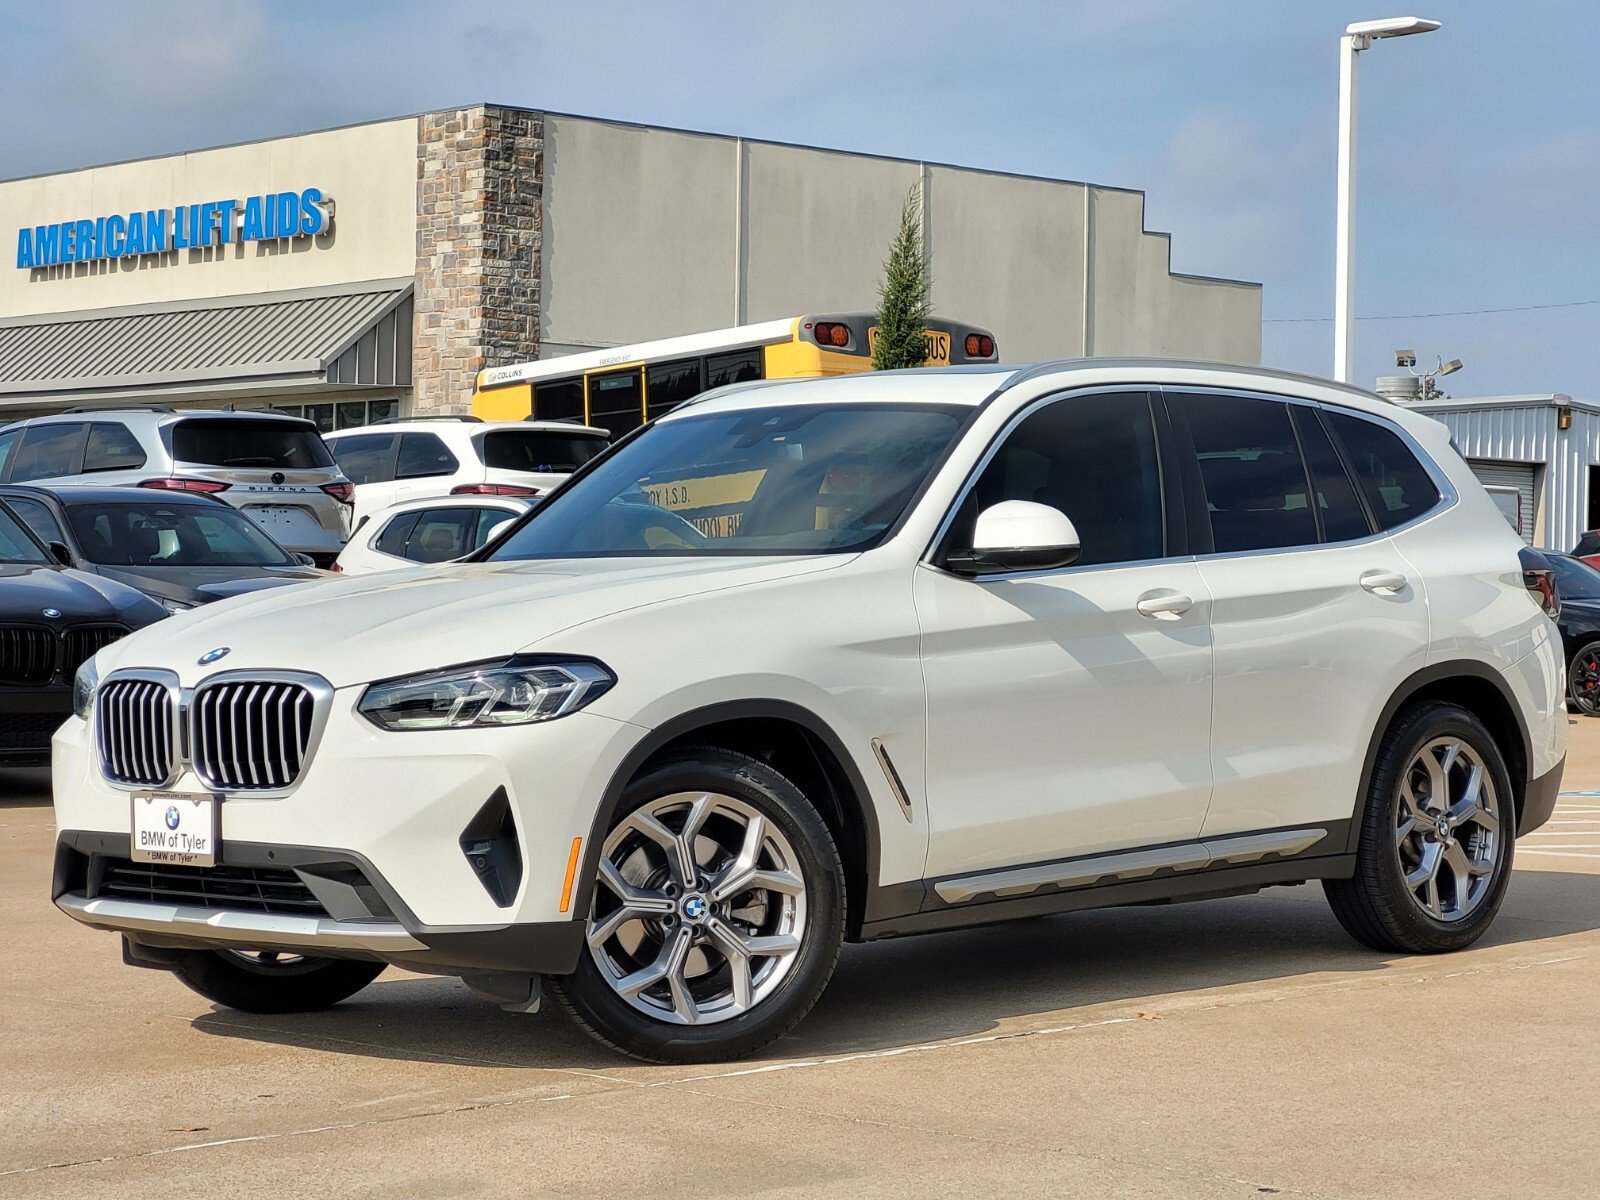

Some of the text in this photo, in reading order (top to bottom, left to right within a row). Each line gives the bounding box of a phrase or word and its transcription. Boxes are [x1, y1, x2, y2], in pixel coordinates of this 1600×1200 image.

[17, 187, 327, 269] AMERICAN LIFT AIDS
[497, 369, 523, 380] COLLINS
[141, 830, 206, 852] BMW of Tyler
[151, 851, 193, 864] BMW of Tyler
